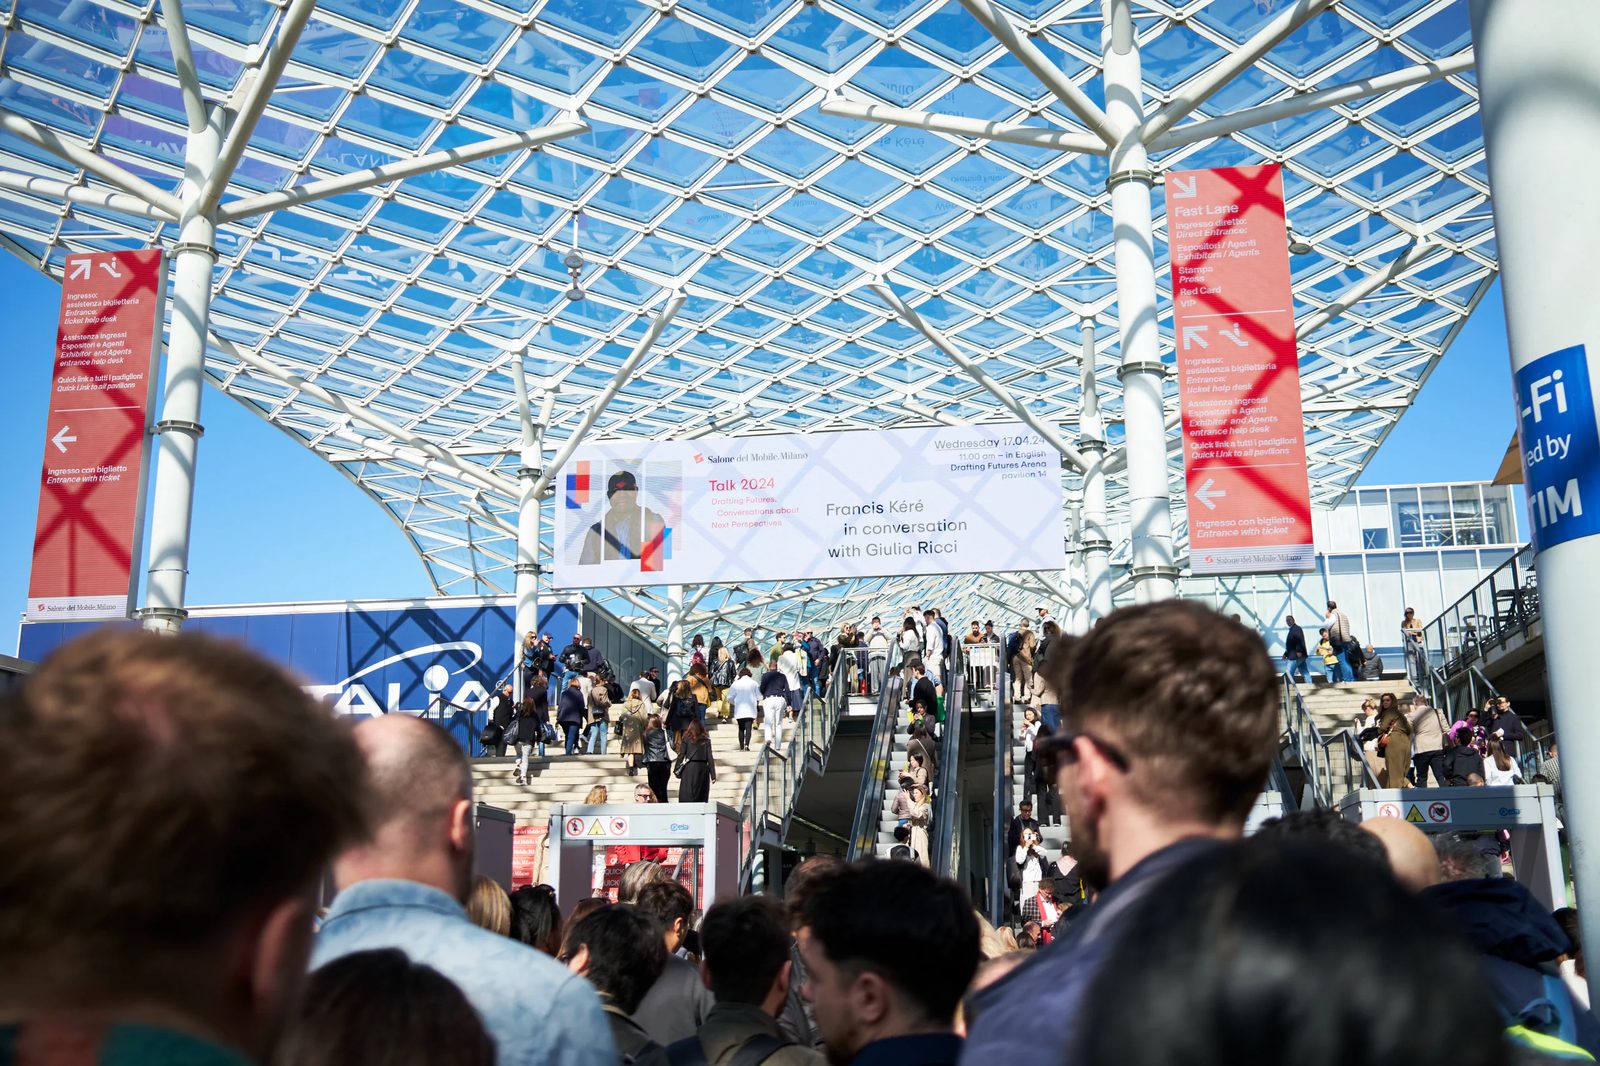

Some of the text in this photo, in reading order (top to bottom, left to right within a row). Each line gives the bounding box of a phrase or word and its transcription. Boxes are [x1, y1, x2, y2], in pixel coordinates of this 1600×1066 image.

[1175, 204, 1239, 217] Fast Lane
[1176, 221, 1213, 230] Ingresso
[1176, 227, 1247, 238] Direct Entrance:
[1177, 243, 1220, 252] Espositori
[1228, 240, 1256, 249] Agenti
[1228, 249, 1260, 258] Agents
[1178, 266, 1213, 274] Stampa
[1200, 286, 1221, 294] Card
[1232, 363, 1276, 372] biglietteria
[112, 373, 143, 382] padiglioni
[107, 382, 135, 390] pavilions
[1212, 384, 1230, 393] help
[1235, 397, 1268, 405] ingressi
[1516, 369, 1568, 432] -Fi
[1240, 406, 1266, 415] Agenti
[1190, 419, 1227, 427] Exhibitor
[1248, 416, 1278, 425] Agents
[1229, 427, 1248, 435] help
[935, 439, 999, 449] Wednesday
[1191, 441, 1213, 450] Quick
[1258, 437, 1296, 447] padiglioni
[1546, 434, 1571, 460] by
[1016, 450, 1046, 459] English
[1254, 447, 1290, 457] pavilions
[709, 478, 774, 491] Talk 2024
[827, 500, 924, 516] Francis Kéré
[1529, 479, 1583, 532] TIM
[717, 507, 773, 516] Conversations
[732, 520, 782, 528] Perspectives
[844, 519, 966, 535] in conversation
[1196, 520, 1236, 528] Ingresso
[1257, 517, 1295, 526] biglietto
[1197, 530, 1239, 538] Entrance
[1262, 526, 1288, 535] ticket
[828, 540, 957, 558] with Giulia Ricci
